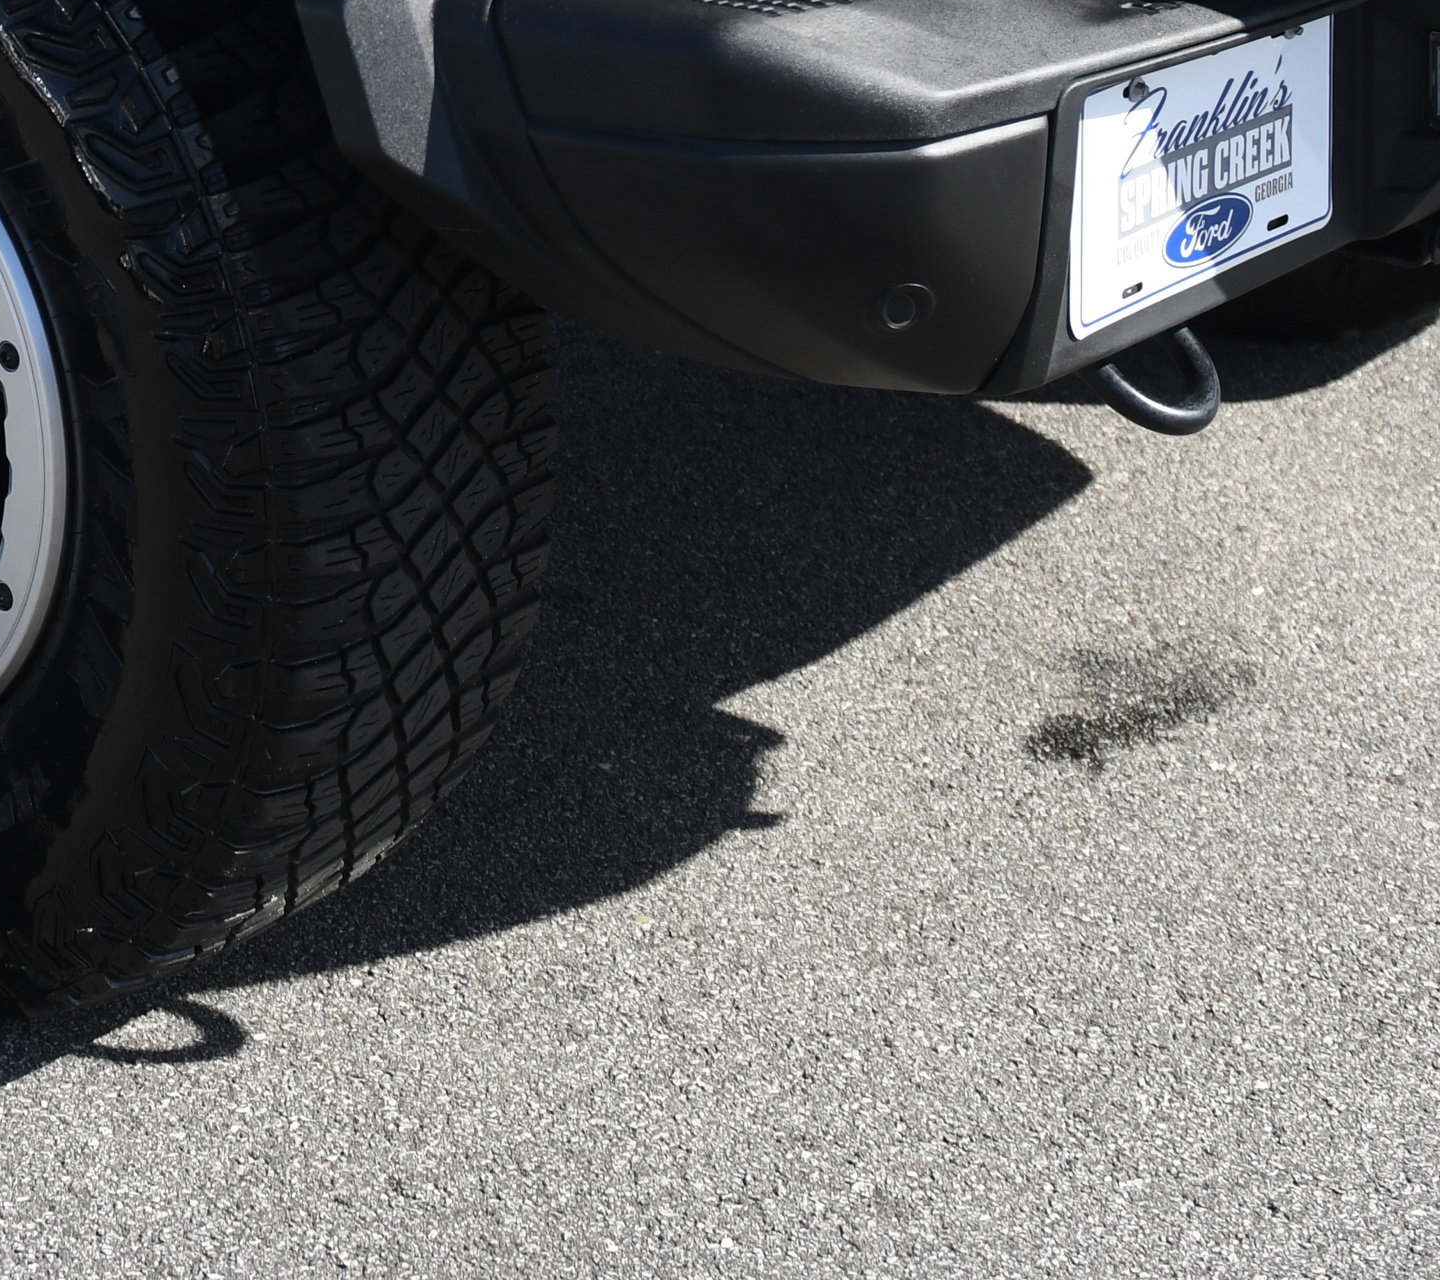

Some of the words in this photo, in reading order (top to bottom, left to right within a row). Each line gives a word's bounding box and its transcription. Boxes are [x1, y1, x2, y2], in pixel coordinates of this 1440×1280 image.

[1120, 53, 1293, 181] Franklin's
[1120, 148, 1210, 234] SPRING
[1214, 114, 1292, 190] CREEK
[1254, 171, 1294, 203] GEORGIA
[1179, 204, 1235, 258] Ford
